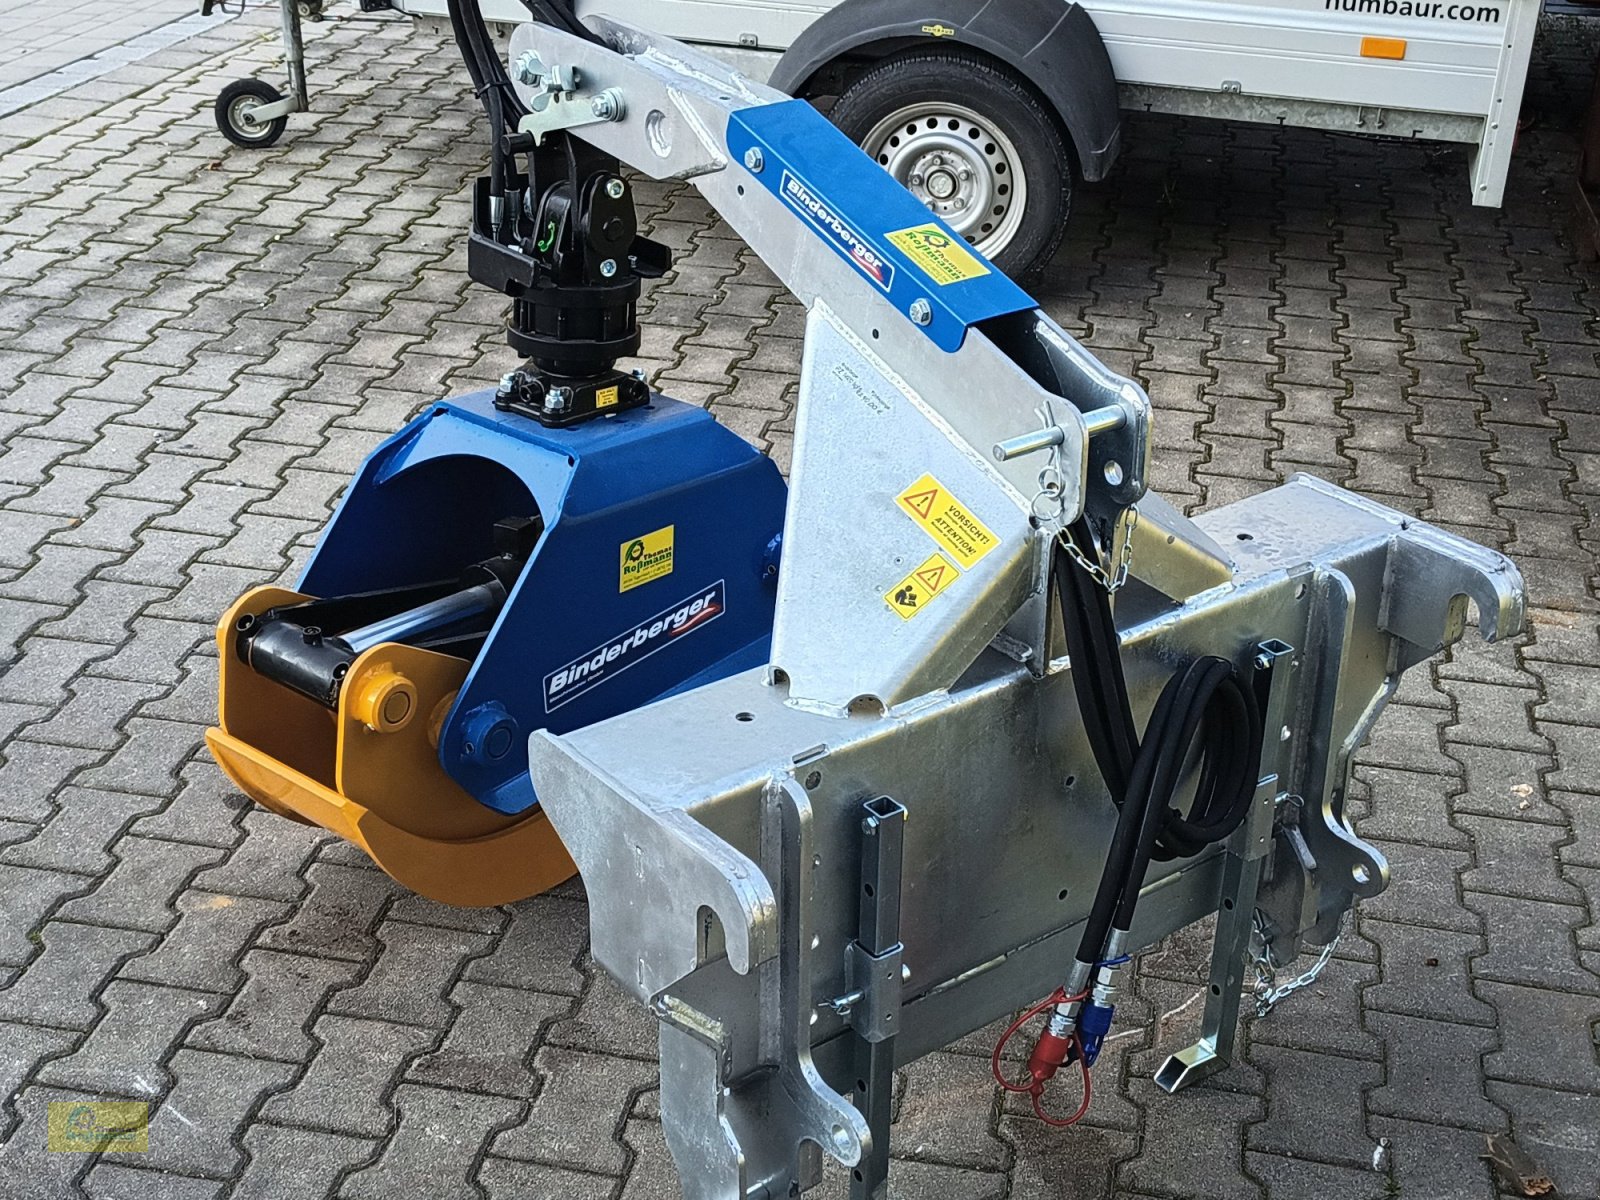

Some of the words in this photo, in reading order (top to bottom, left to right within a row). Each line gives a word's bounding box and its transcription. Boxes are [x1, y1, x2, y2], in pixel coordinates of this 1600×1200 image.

[787, 179, 883, 268] Binderberger
[934, 517, 977, 555] ATTENTION!
[949, 505, 990, 545] VORSICHT!
[623, 551, 672, 575] Roßmann
[549, 591, 716, 695] Binderberger
